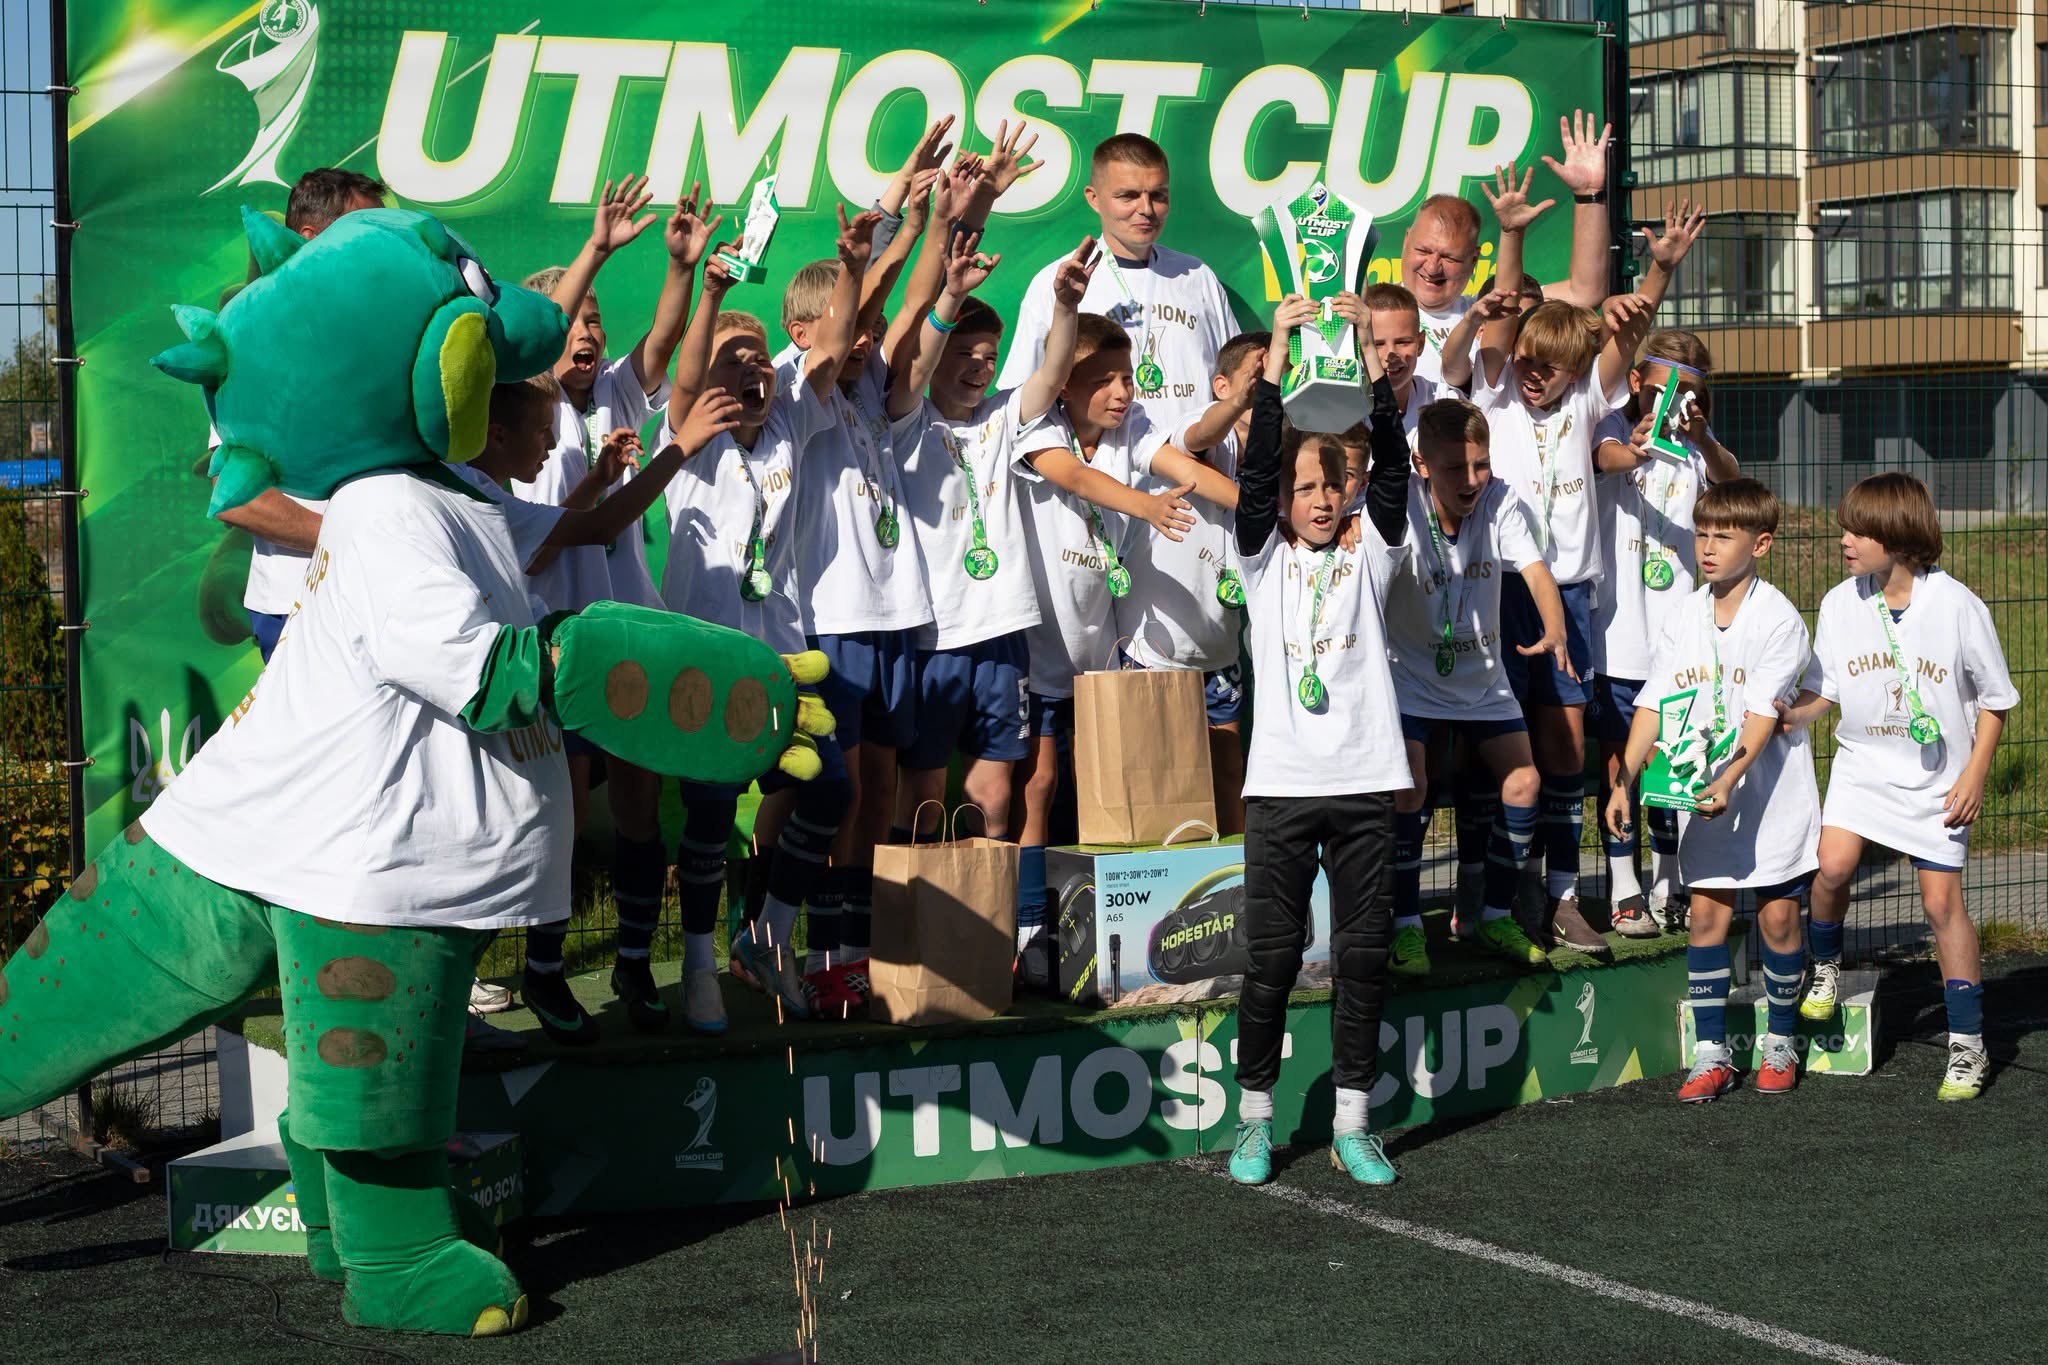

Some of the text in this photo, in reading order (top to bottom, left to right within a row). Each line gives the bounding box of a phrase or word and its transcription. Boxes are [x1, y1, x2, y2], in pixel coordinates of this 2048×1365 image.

[377, 31, 1535, 217] UTMOST CUP
[1297, 217, 1350, 230] UTMOST
[1307, 226, 1337, 236] CUP
[1174, 383, 1195, 398] CUP
[1563, 477, 1584, 495] CUP
[1847, 652, 1948, 685] CHAMONS
[1105, 890, 1151, 908] 300W
[1106, 913, 1124, 923] A65
[1161, 913, 1235, 952] HOPESTAR
[1688, 985, 1713, 995] CDK
[1814, 1033, 1860, 1052] ЗСУ
[191, 1203, 307, 1232] ДЯКУЄМ
